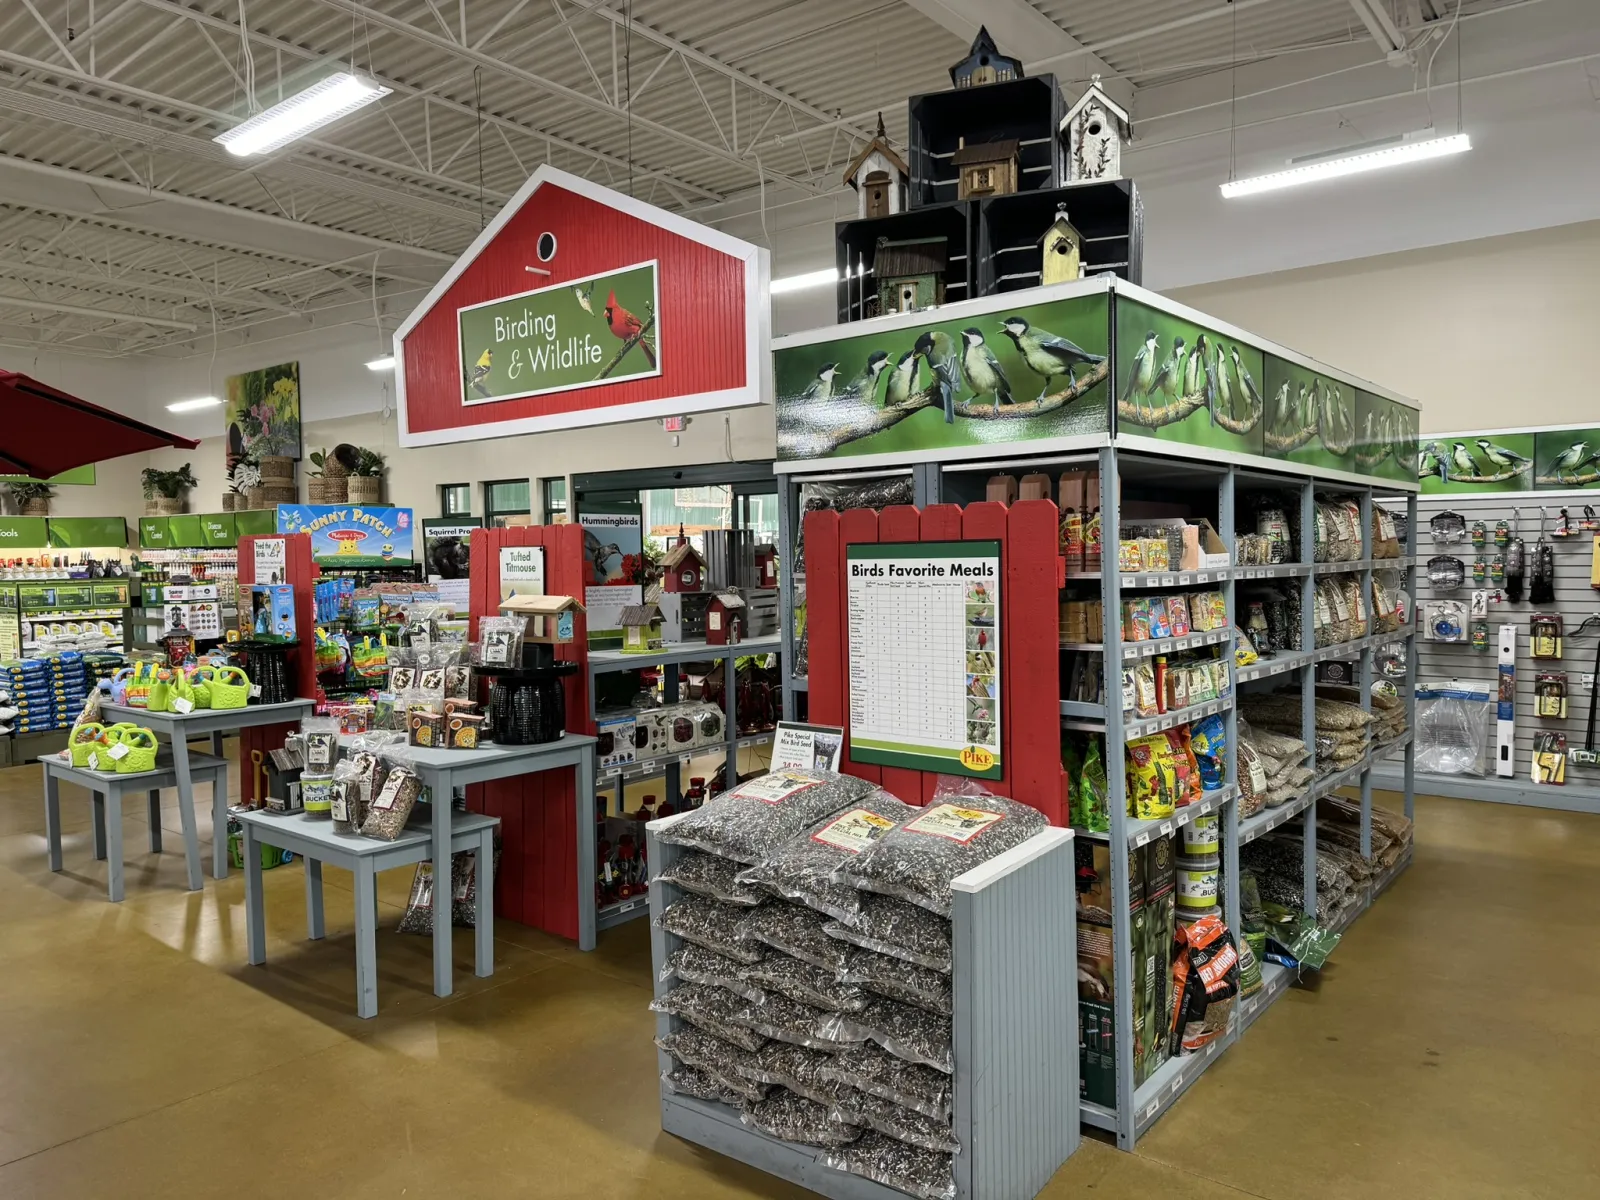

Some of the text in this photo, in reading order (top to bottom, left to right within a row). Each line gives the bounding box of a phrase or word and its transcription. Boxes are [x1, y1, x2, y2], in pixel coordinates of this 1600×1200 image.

[494, 308, 556, 342] Birding
[508, 333, 602, 379] & Wildlife
[300, 508, 393, 538] SUNNY PATCH
[581, 516, 638, 528] Hummingbirds
[428, 528, 457, 537] Squirrel
[510, 551, 531, 561] Tufted
[506, 562, 536, 572] Titmouse
[851, 562, 994, 577] Birds Favorite Meals
[963, 750, 991, 763] PIKE
